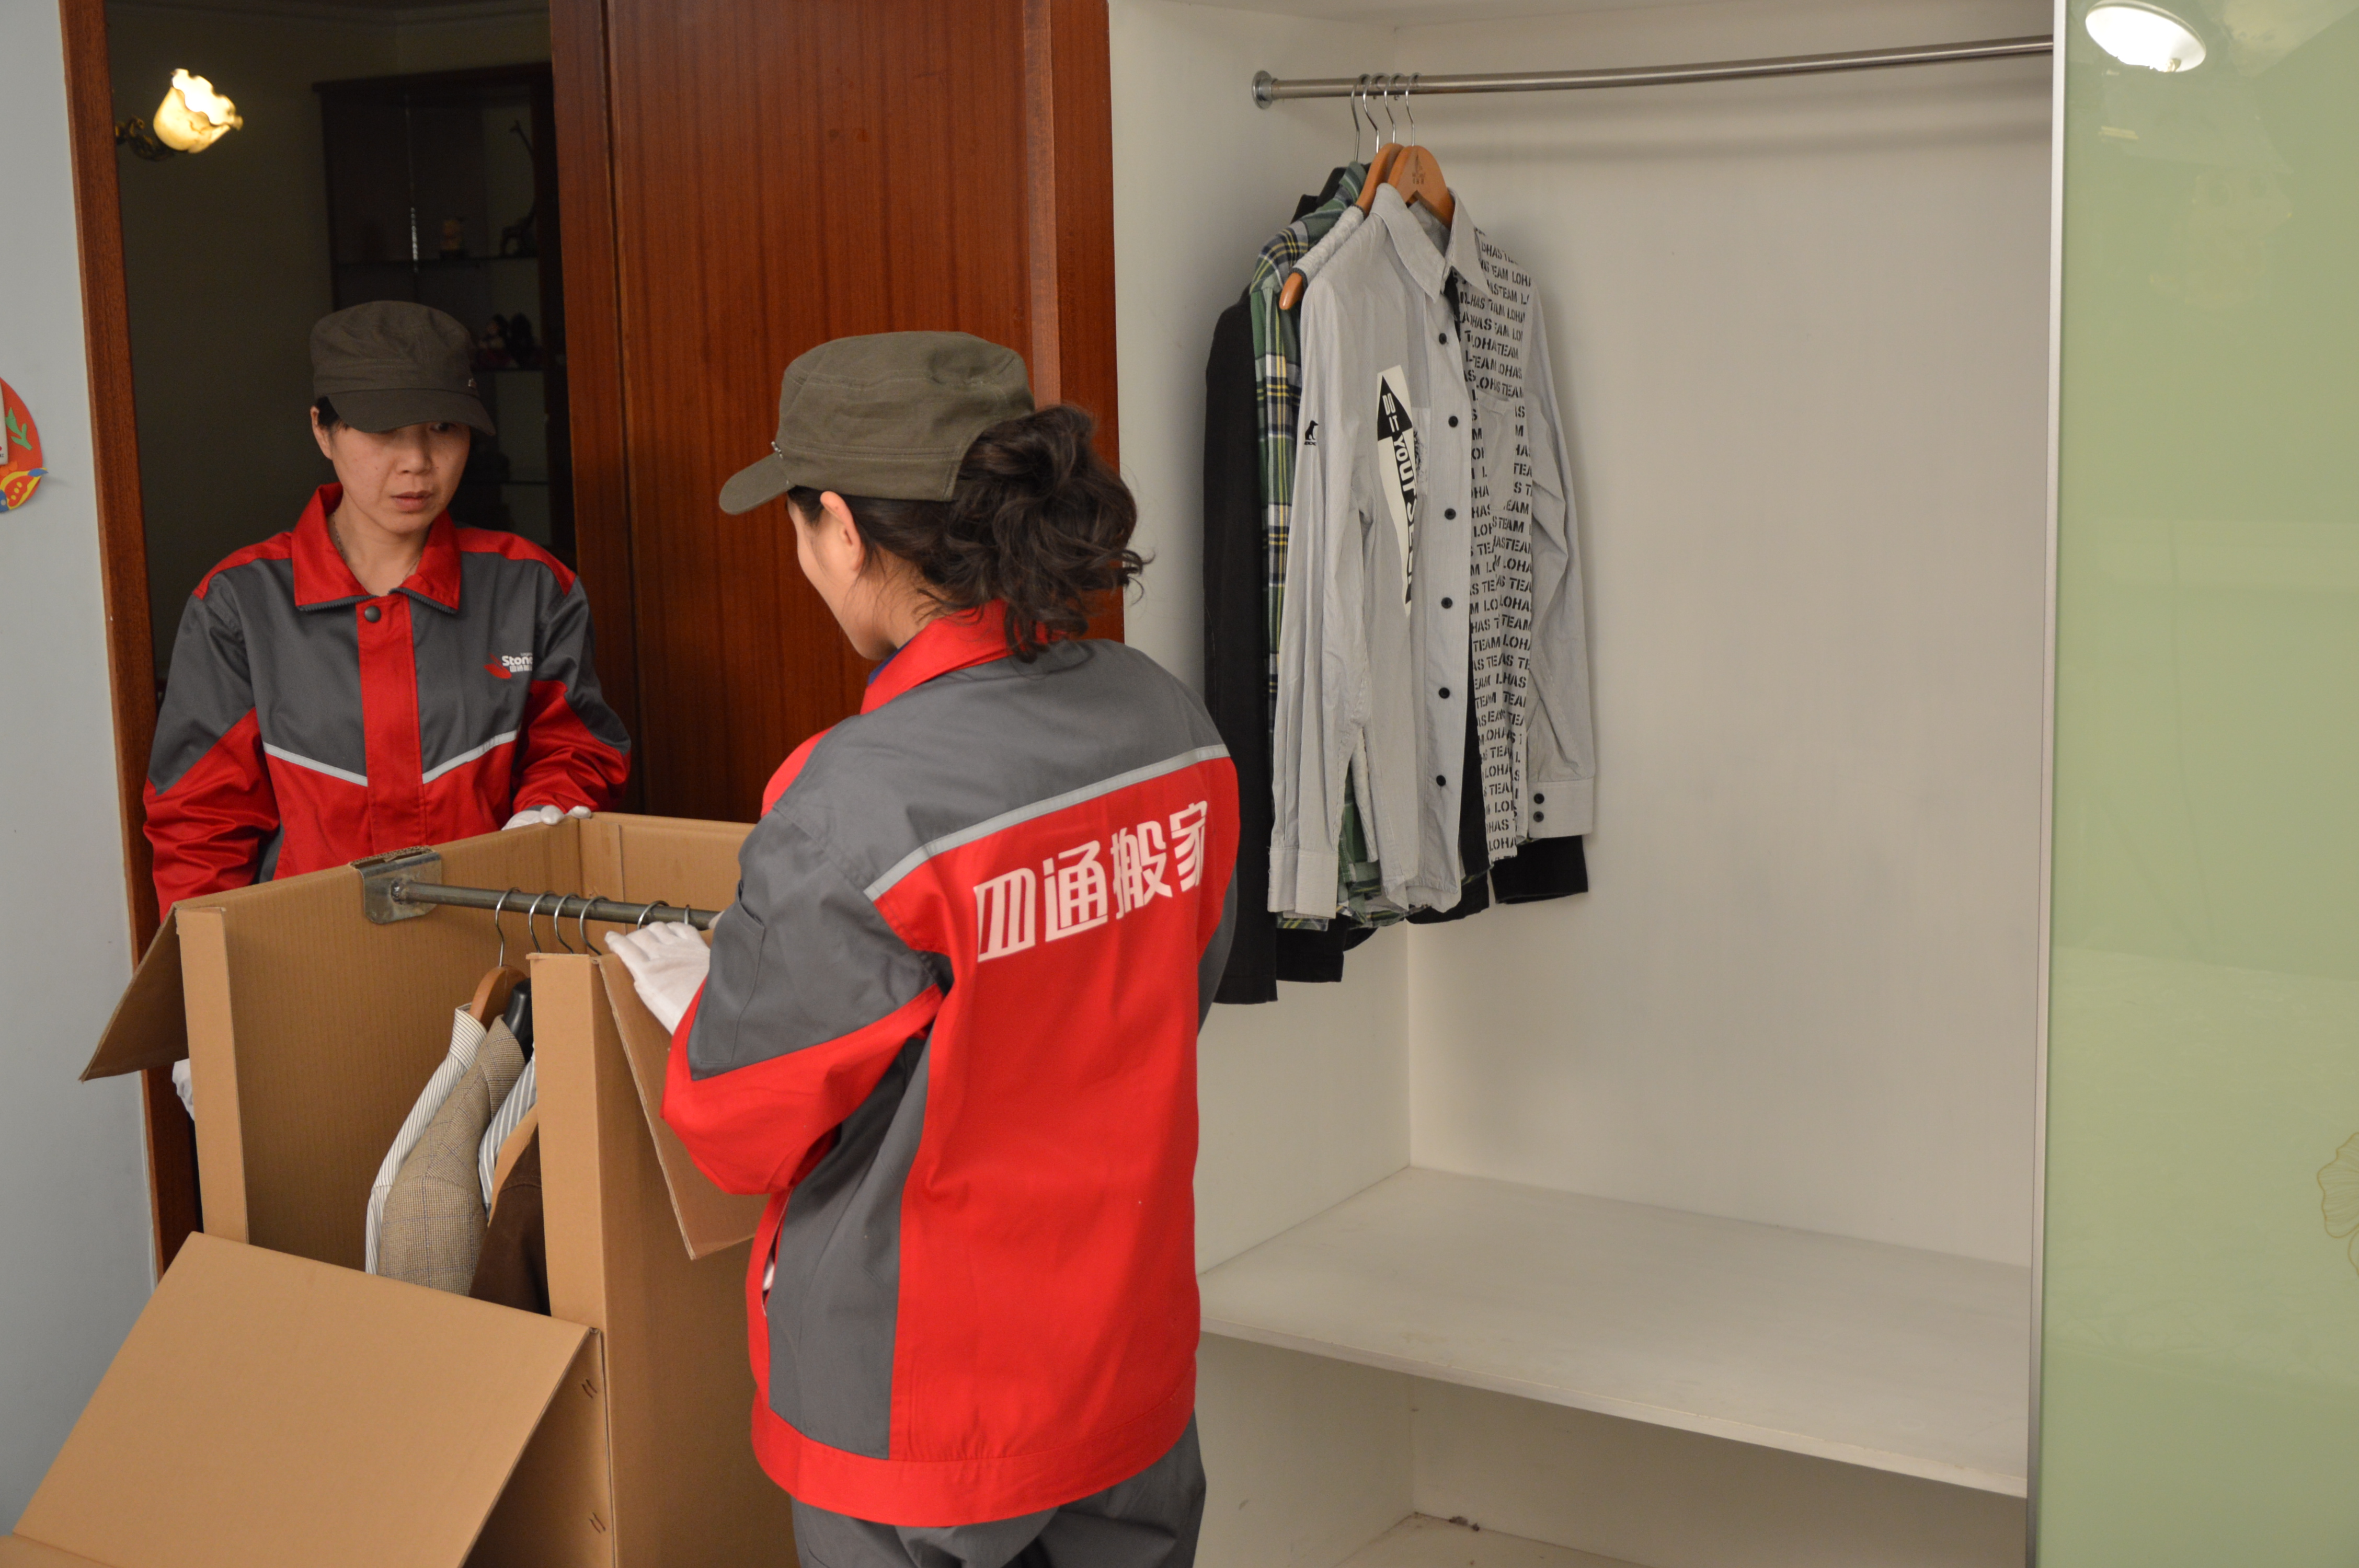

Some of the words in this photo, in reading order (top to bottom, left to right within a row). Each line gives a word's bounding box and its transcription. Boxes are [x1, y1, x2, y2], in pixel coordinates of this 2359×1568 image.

[1472, 636, 1501, 652] TEAM
[973, 800, 1208, 963] 四通搬家
